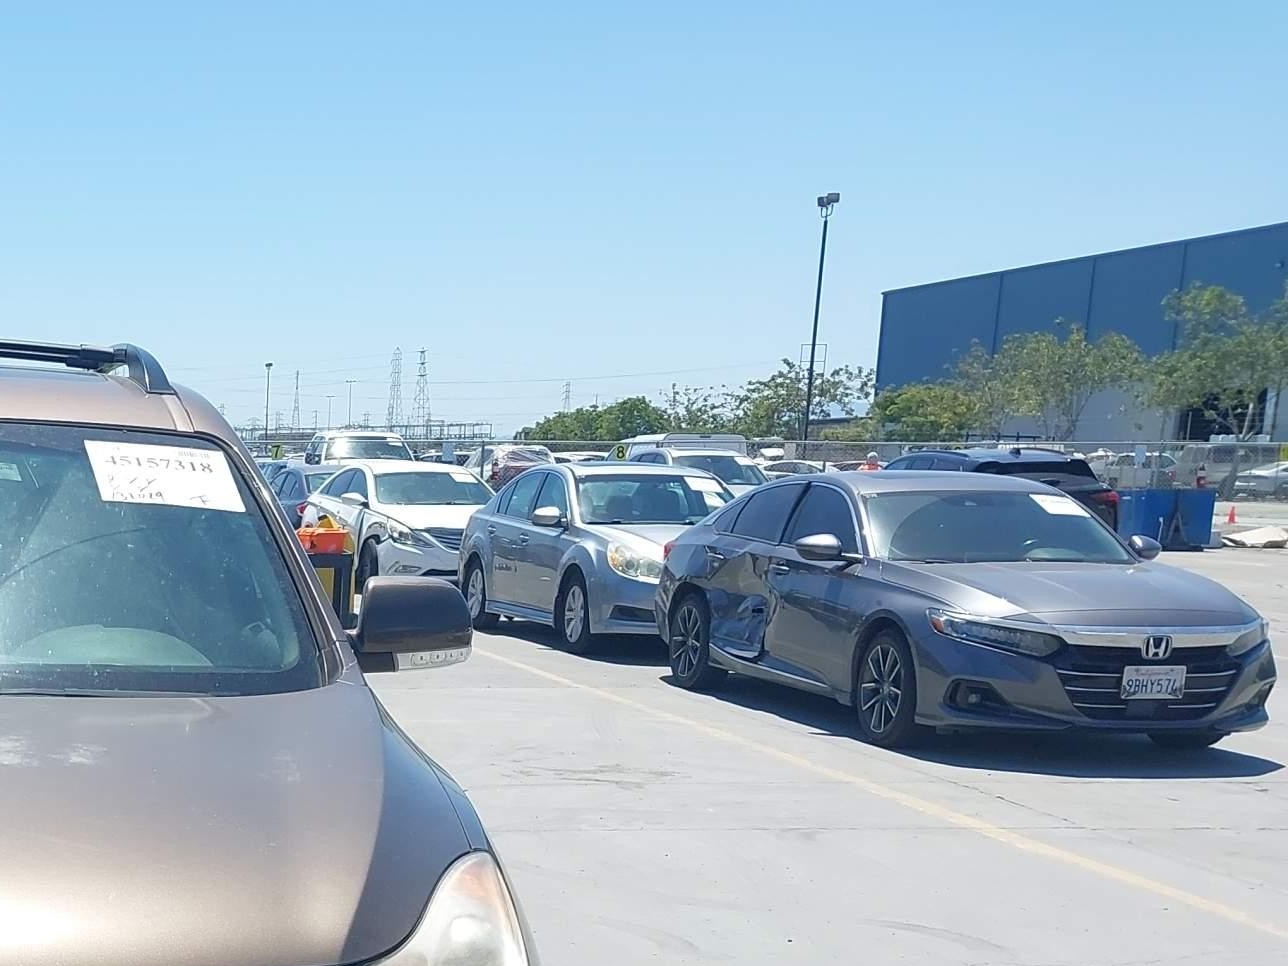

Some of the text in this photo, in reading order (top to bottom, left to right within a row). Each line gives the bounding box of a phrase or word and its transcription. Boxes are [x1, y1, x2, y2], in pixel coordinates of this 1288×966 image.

[272, 445, 281, 459] 7
[616, 445, 625, 459] 8
[104, 455, 214, 474] 45157318
